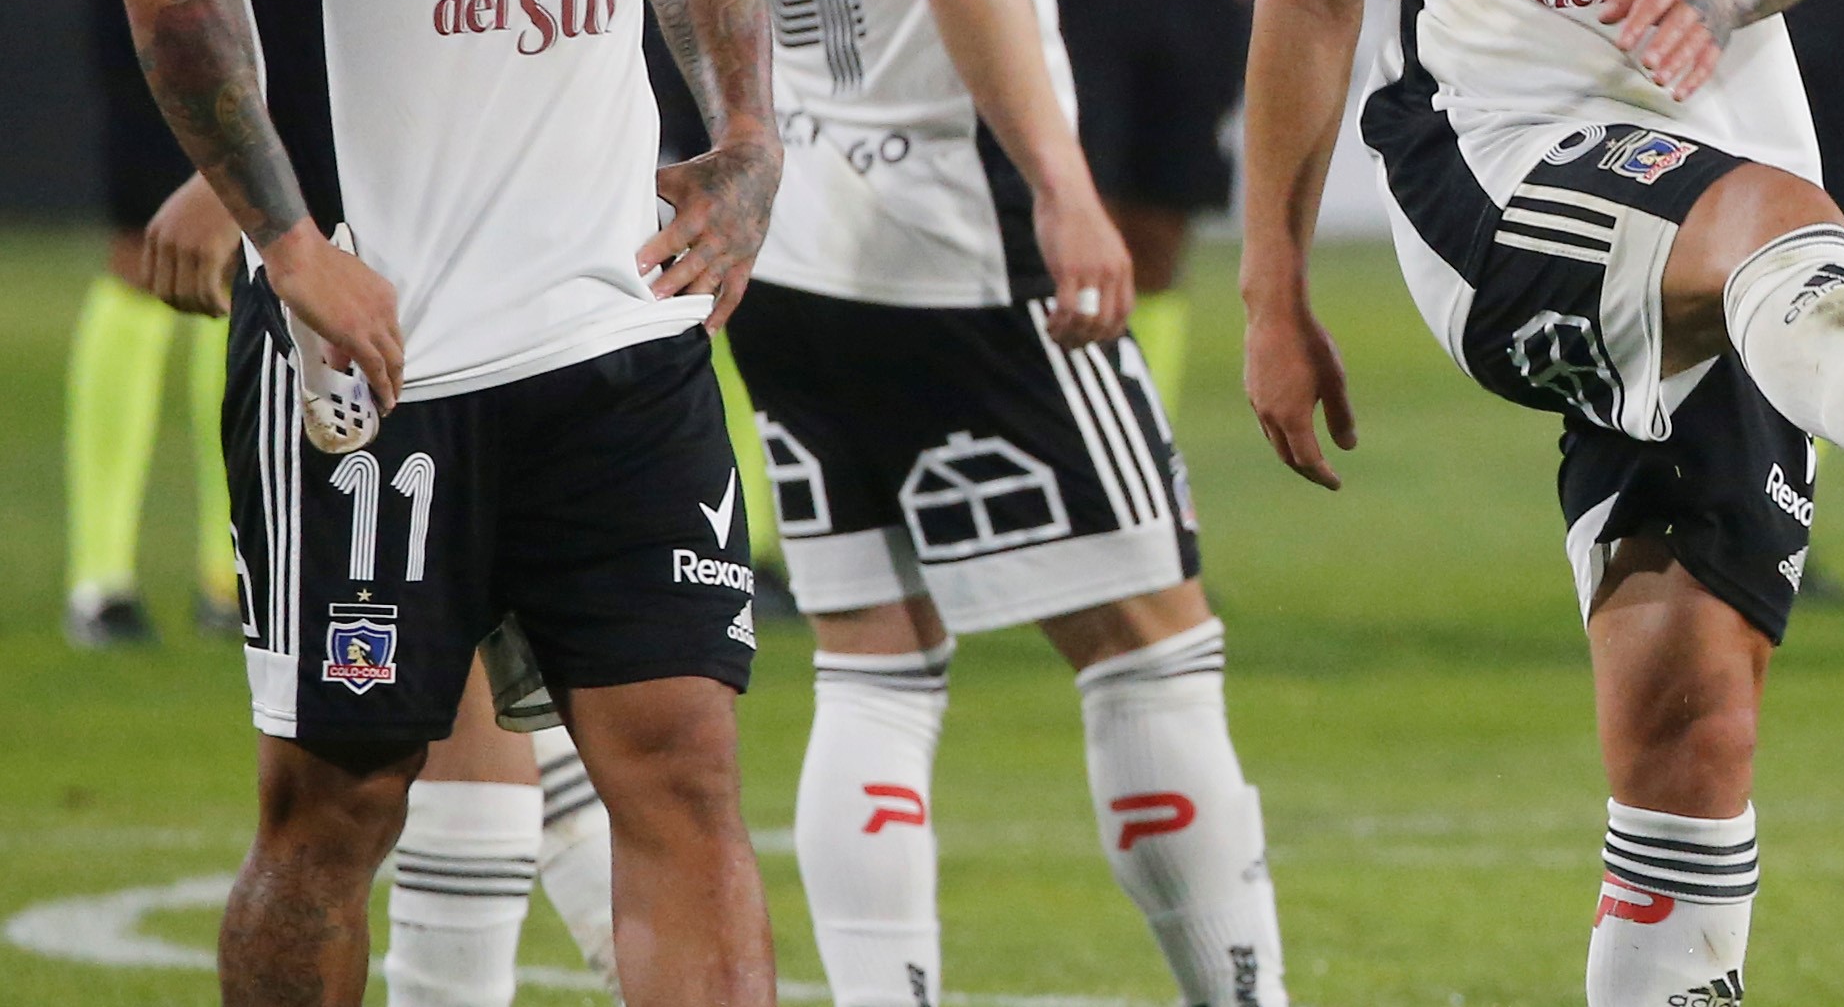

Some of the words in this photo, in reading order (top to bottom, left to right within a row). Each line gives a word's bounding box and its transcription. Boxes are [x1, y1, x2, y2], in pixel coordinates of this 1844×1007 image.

[848, 132, 911, 175] GO
[328, 449, 436, 581] 11
[1765, 462, 1815, 527] Rexo
[329, 667, 389, 678] COLO-COLO
